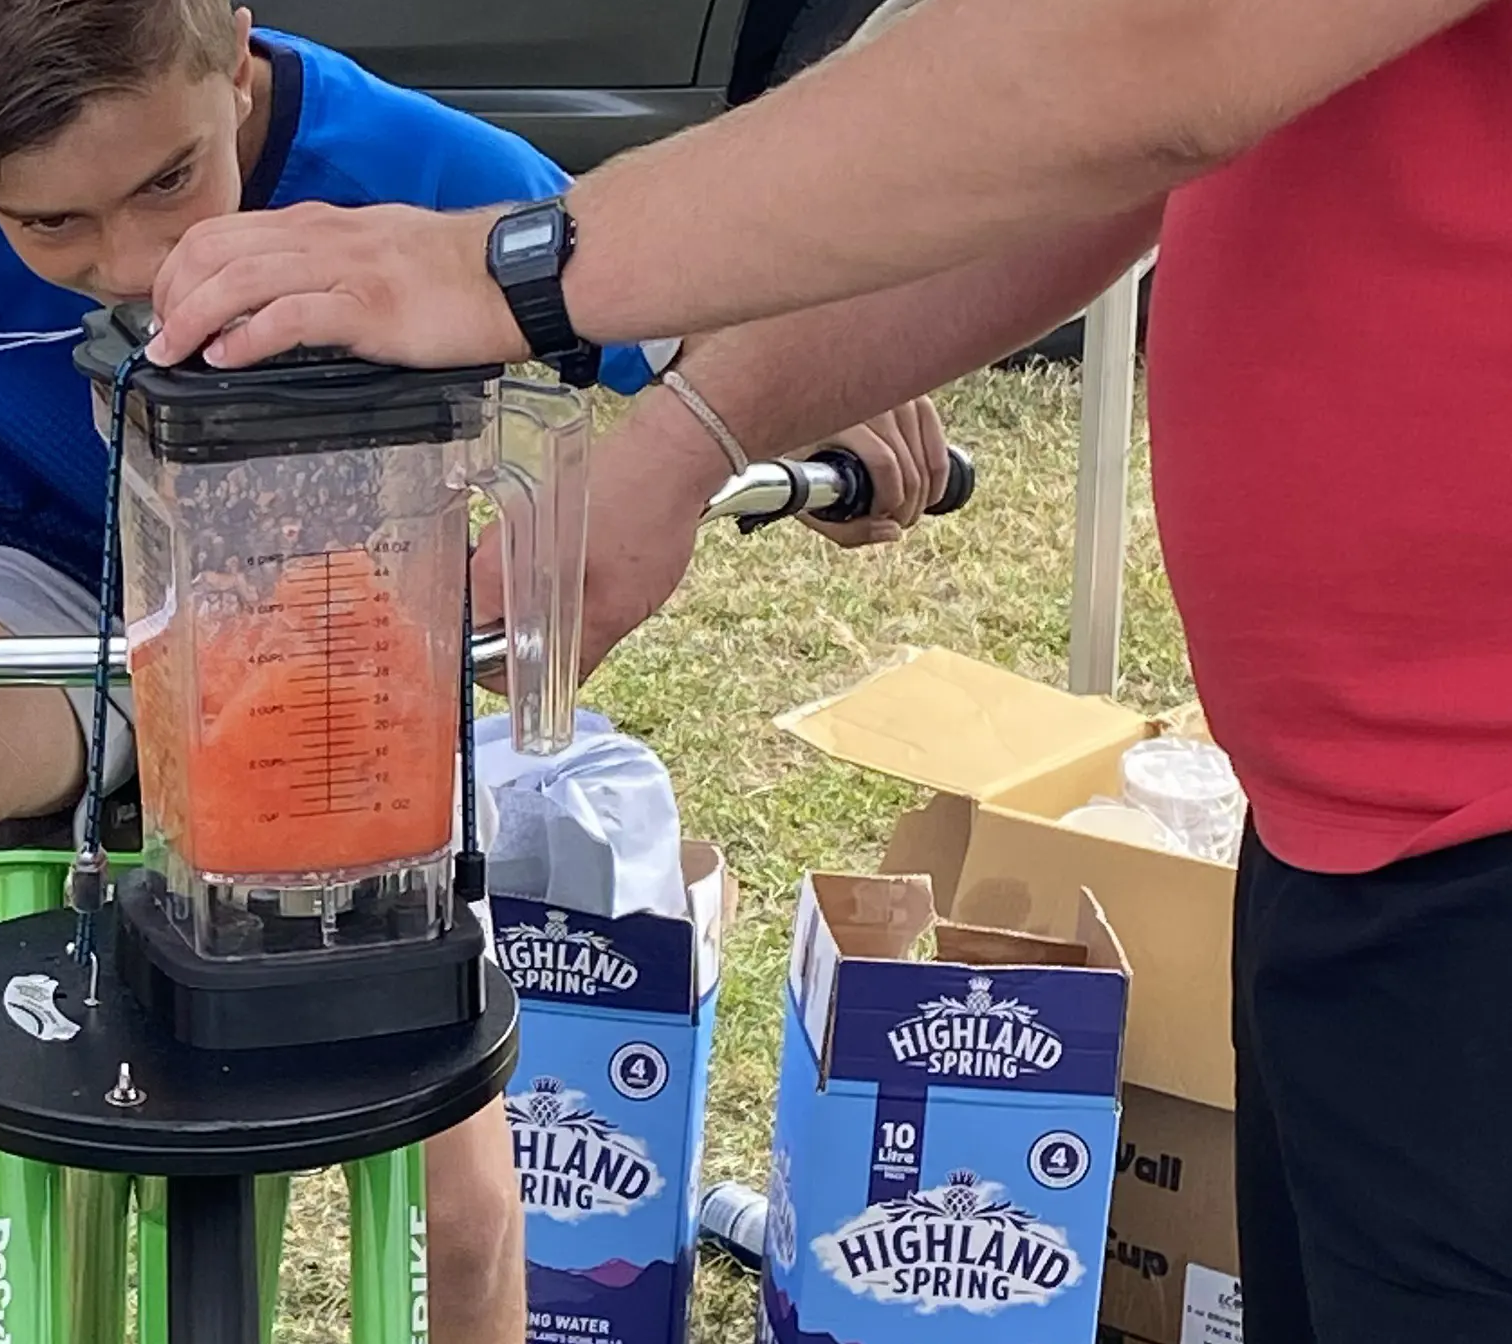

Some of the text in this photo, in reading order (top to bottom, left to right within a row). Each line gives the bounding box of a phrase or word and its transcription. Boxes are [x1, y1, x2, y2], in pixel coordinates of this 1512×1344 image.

[9, 460, 48, 474] IFCO
[497, 940, 638, 990] IGHLAND
[512, 969, 596, 996] SPRING
[887, 1017, 1063, 1070] HIGHLAND
[630, 1058, 646, 1079] 4
[927, 1049, 1018, 1078] SPRING
[881, 1122, 916, 1149] 10
[512, 1129, 651, 1200] HLAND
[878, 1147, 915, 1165] Litre
[1050, 1147, 1067, 1167] 4
[520, 1172, 593, 1210] RING
[838, 1223, 1070, 1289] HIGHLAND
[1107, 1226, 1168, 1280] up
[893, 1267, 1009, 1301] SPRING
[555, 1315, 610, 1334] WATER
